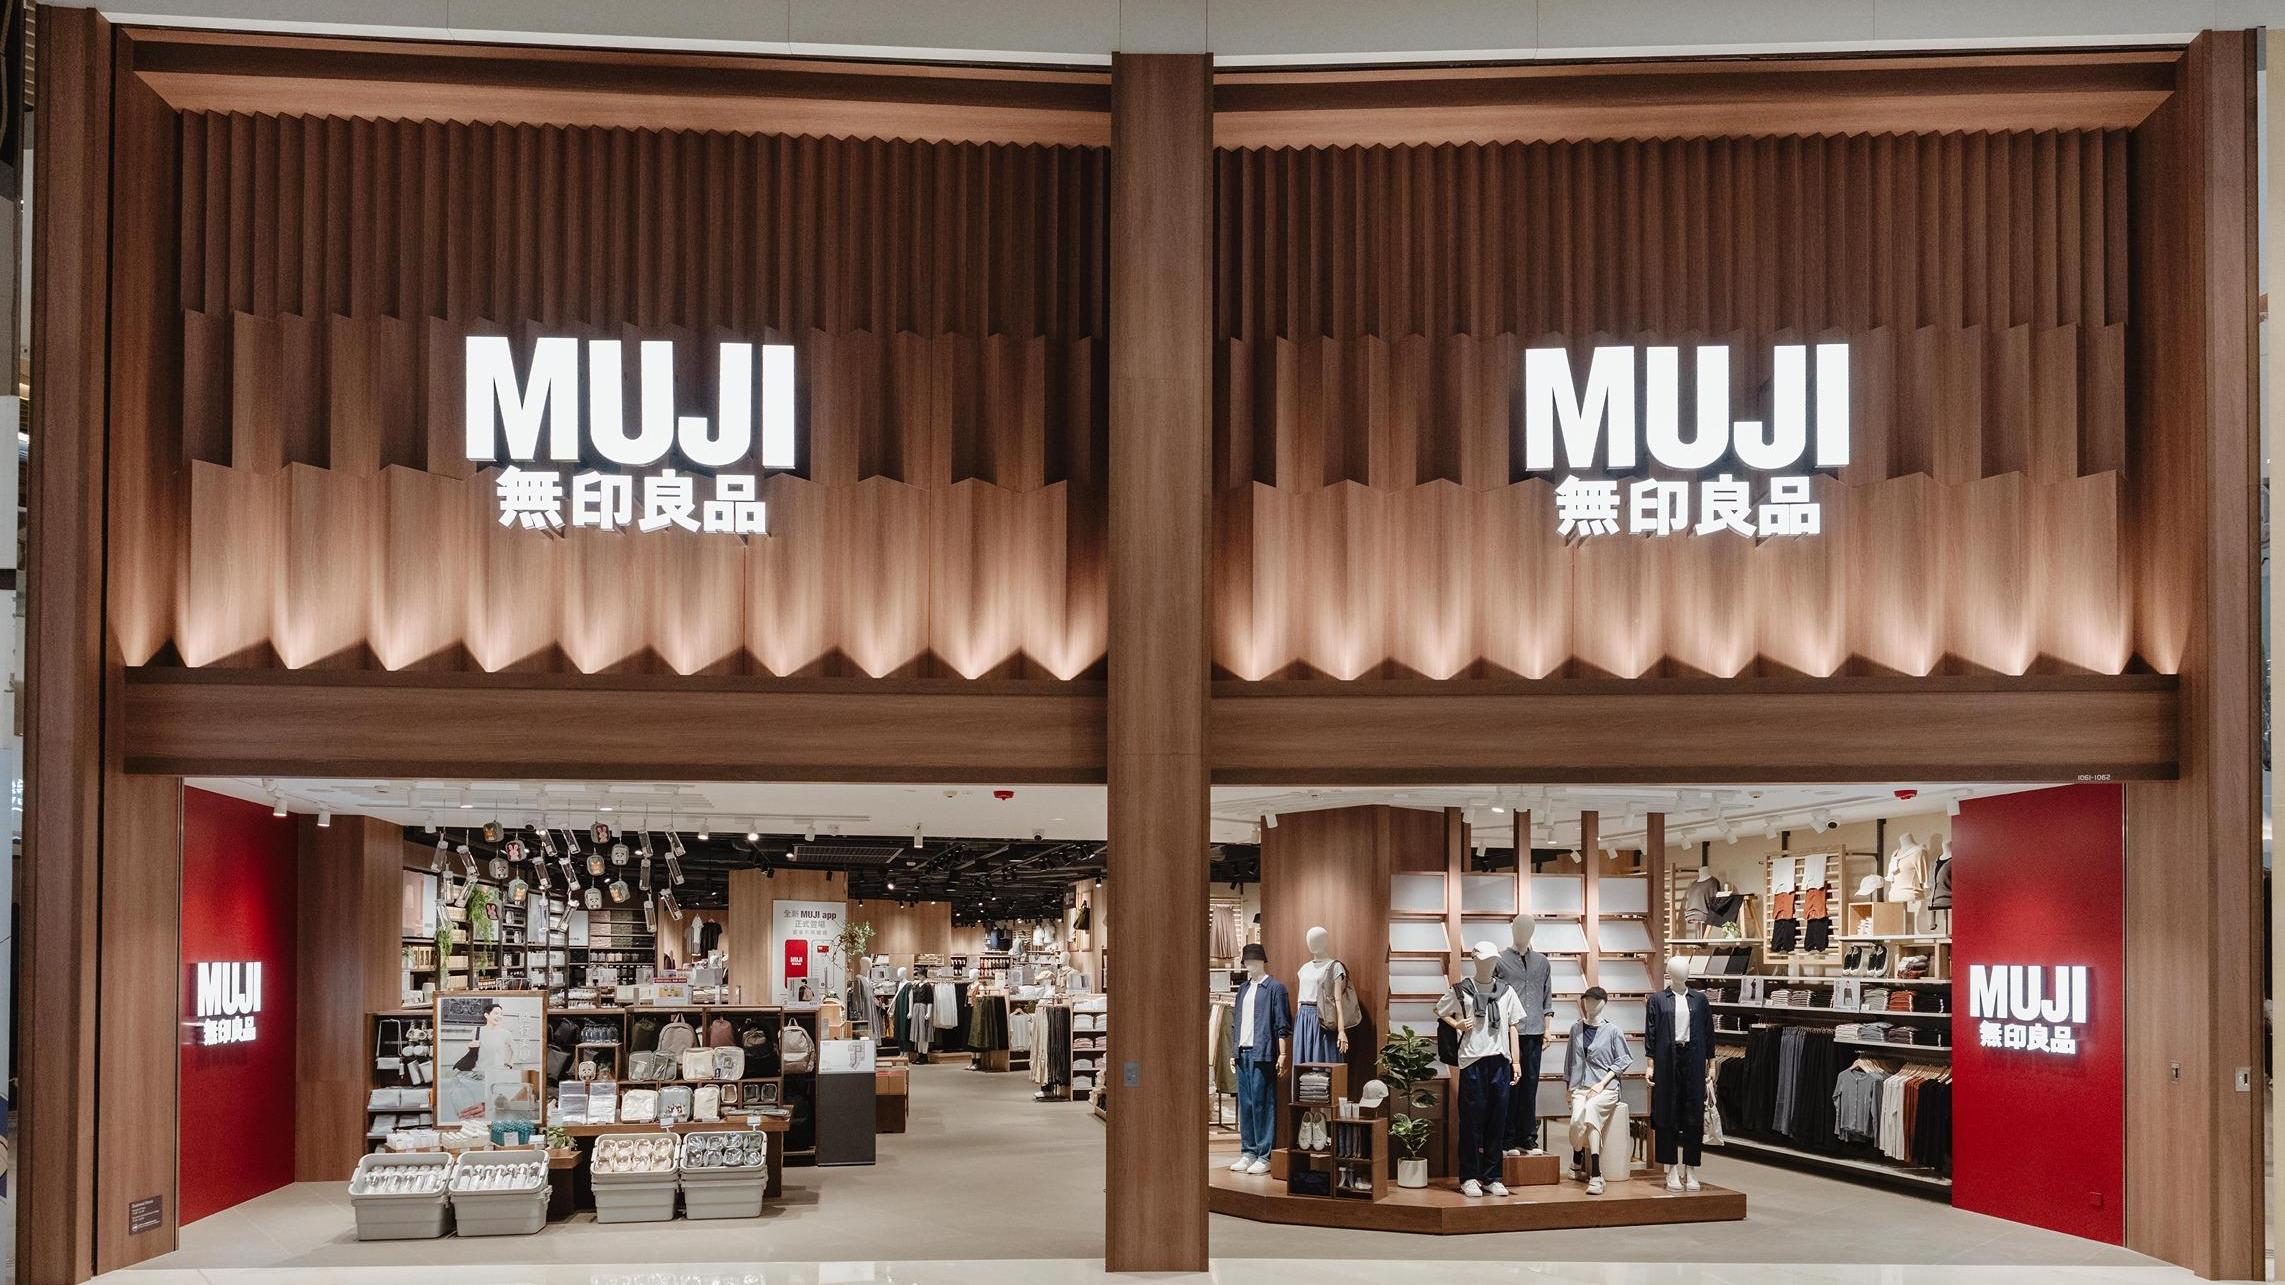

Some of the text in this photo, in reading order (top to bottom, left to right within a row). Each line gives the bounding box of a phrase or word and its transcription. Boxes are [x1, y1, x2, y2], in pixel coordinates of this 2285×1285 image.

[466, 336, 795, 469] MUJI
[1525, 344, 1849, 471] MUJI
[496, 465, 767, 534] 無印良品
[1554, 474, 1821, 537] 無印良品
[2077, 774, 2111, 782] 1061-1062
[800, 910, 821, 919] MUJI
[822, 912, 837, 921] app
[198, 962, 261, 1017] MUJI
[1969, 965, 2087, 1023] MUJI
[1979, 1020, 2076, 1054] 無印良品
